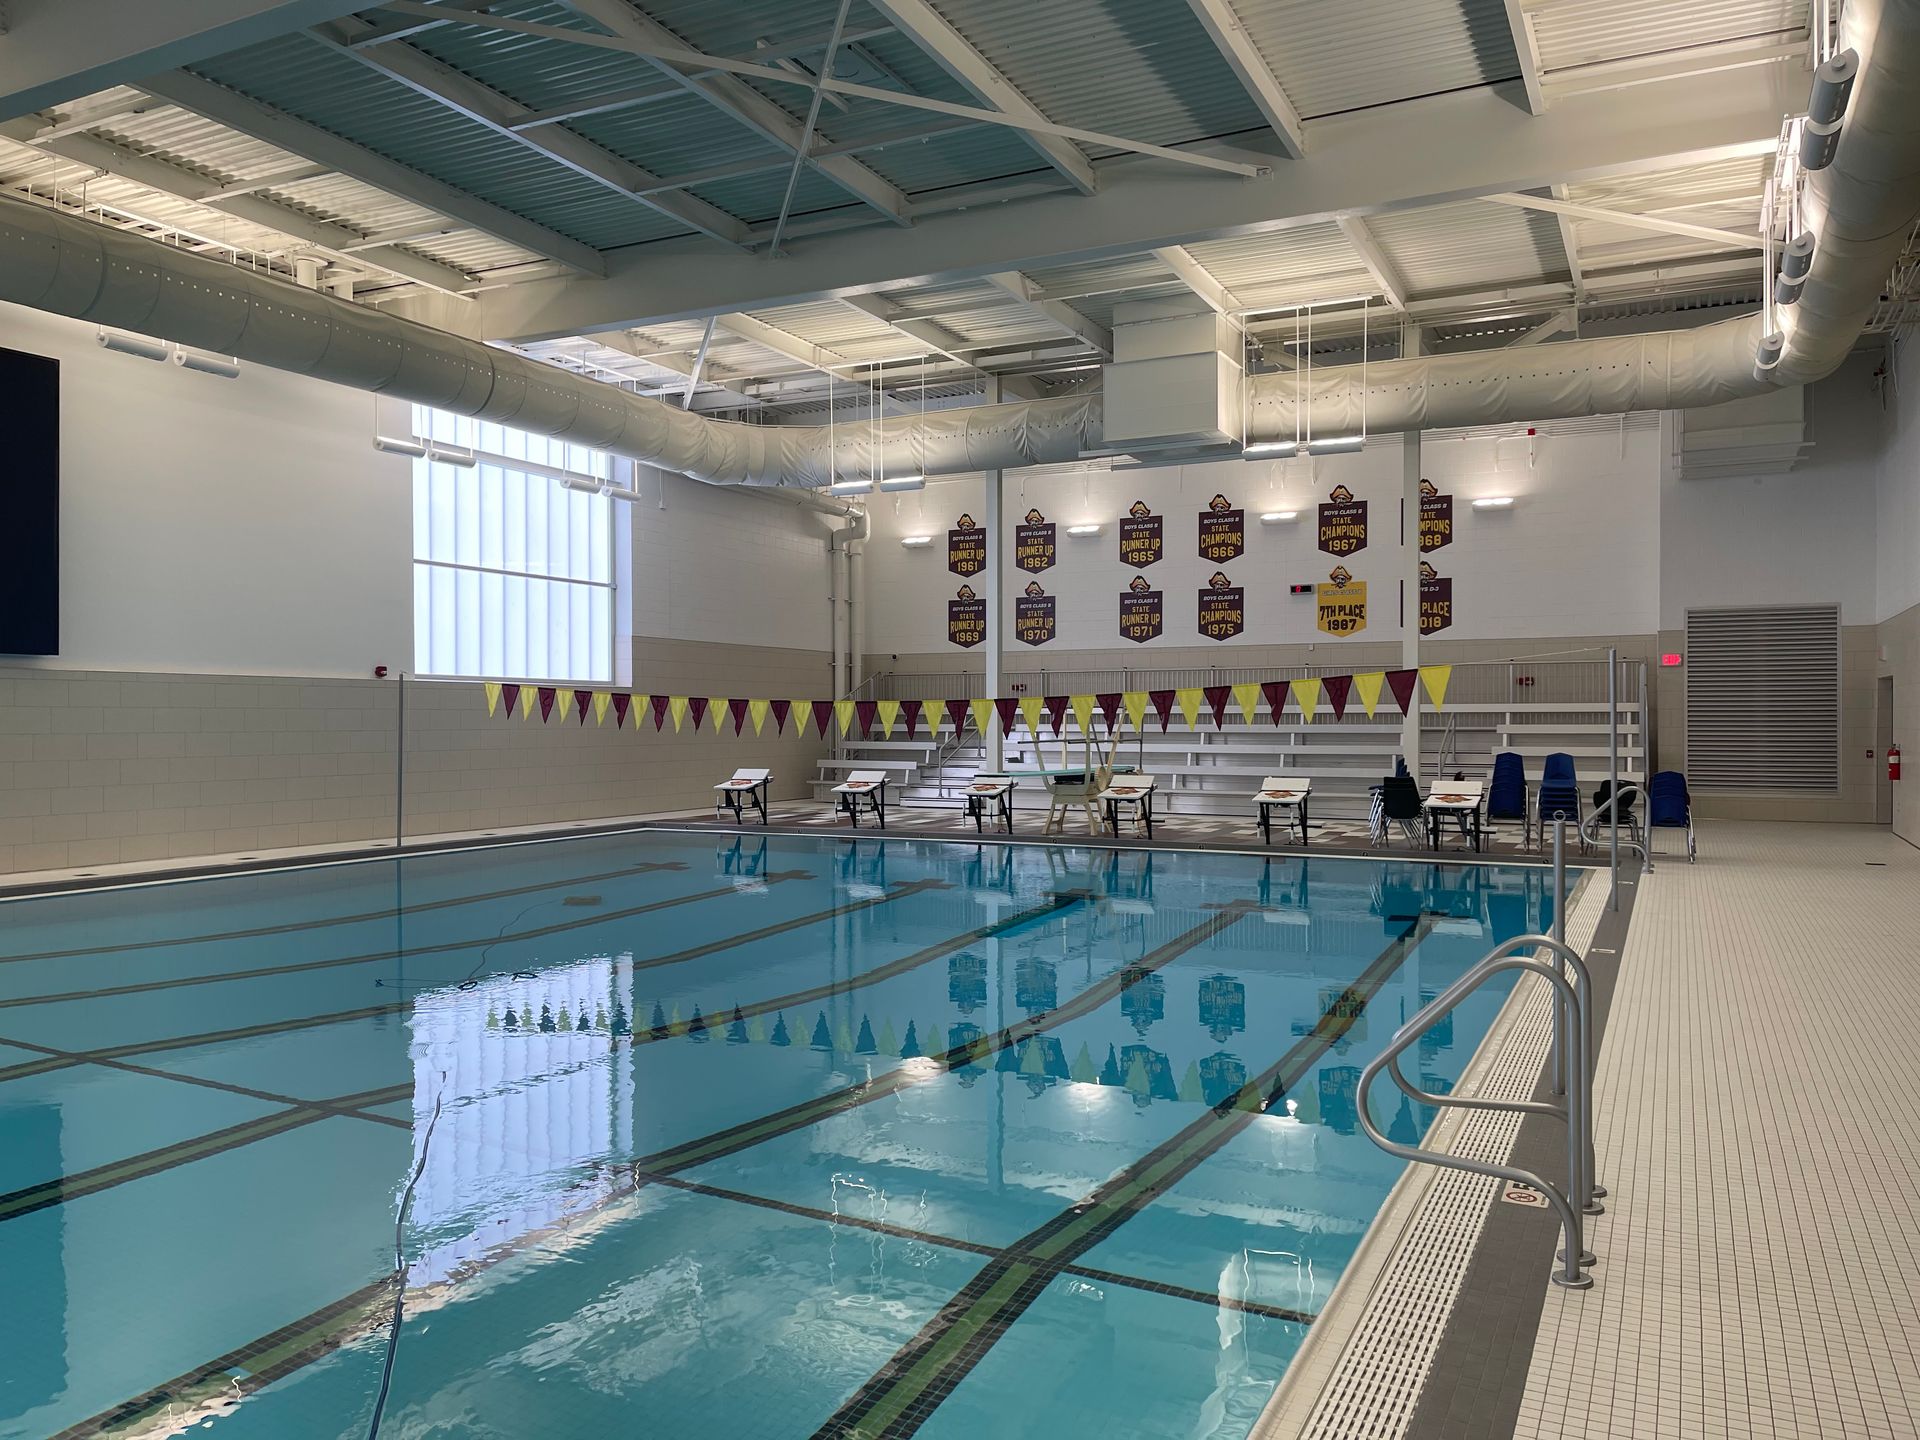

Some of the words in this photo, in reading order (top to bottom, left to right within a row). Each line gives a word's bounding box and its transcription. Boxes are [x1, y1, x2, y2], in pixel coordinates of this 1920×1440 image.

[1321, 525, 1365, 541] CHAMPIONS
[1420, 520, 1450, 534] MPIONS
[1122, 539, 1149, 553] RUNNER
[1151, 538, 1161, 551] UP
[1201, 532, 1242, 548] CHAMPIONS
[1328, 539, 1357, 551] 1967
[950, 550, 975, 563] RUNNER
[976, 549, 985, 561] UP
[1018, 545, 1043, 560] RUNNER
[1045, 545, 1054, 556] UP
[1128, 551, 1154, 562] 1965
[1208, 546, 1235, 558] 1966
[957, 561, 978, 572] 1961
[1024, 557, 1048, 568] 1962
[1320, 605, 1336, 621] 7TH
[1338, 604, 1365, 619] PLACE
[1422, 602, 1450, 616] PLACE
[1122, 614, 1149, 628] RUNNER
[1151, 613, 1161, 626] UP
[1200, 610, 1241, 625] CHAMPIONS
[1420, 617, 1442, 628] 018
[950, 621, 975, 633] RUNNER
[976, 621, 985, 632] UP
[1018, 618, 1043, 632] RUNNER
[1045, 618, 1054, 629] UP
[1130, 626, 1153, 637] 1971
[1208, 624, 1234, 635] 1975
[956, 632, 979, 642] 1969
[1024, 630, 1048, 640] 1970
